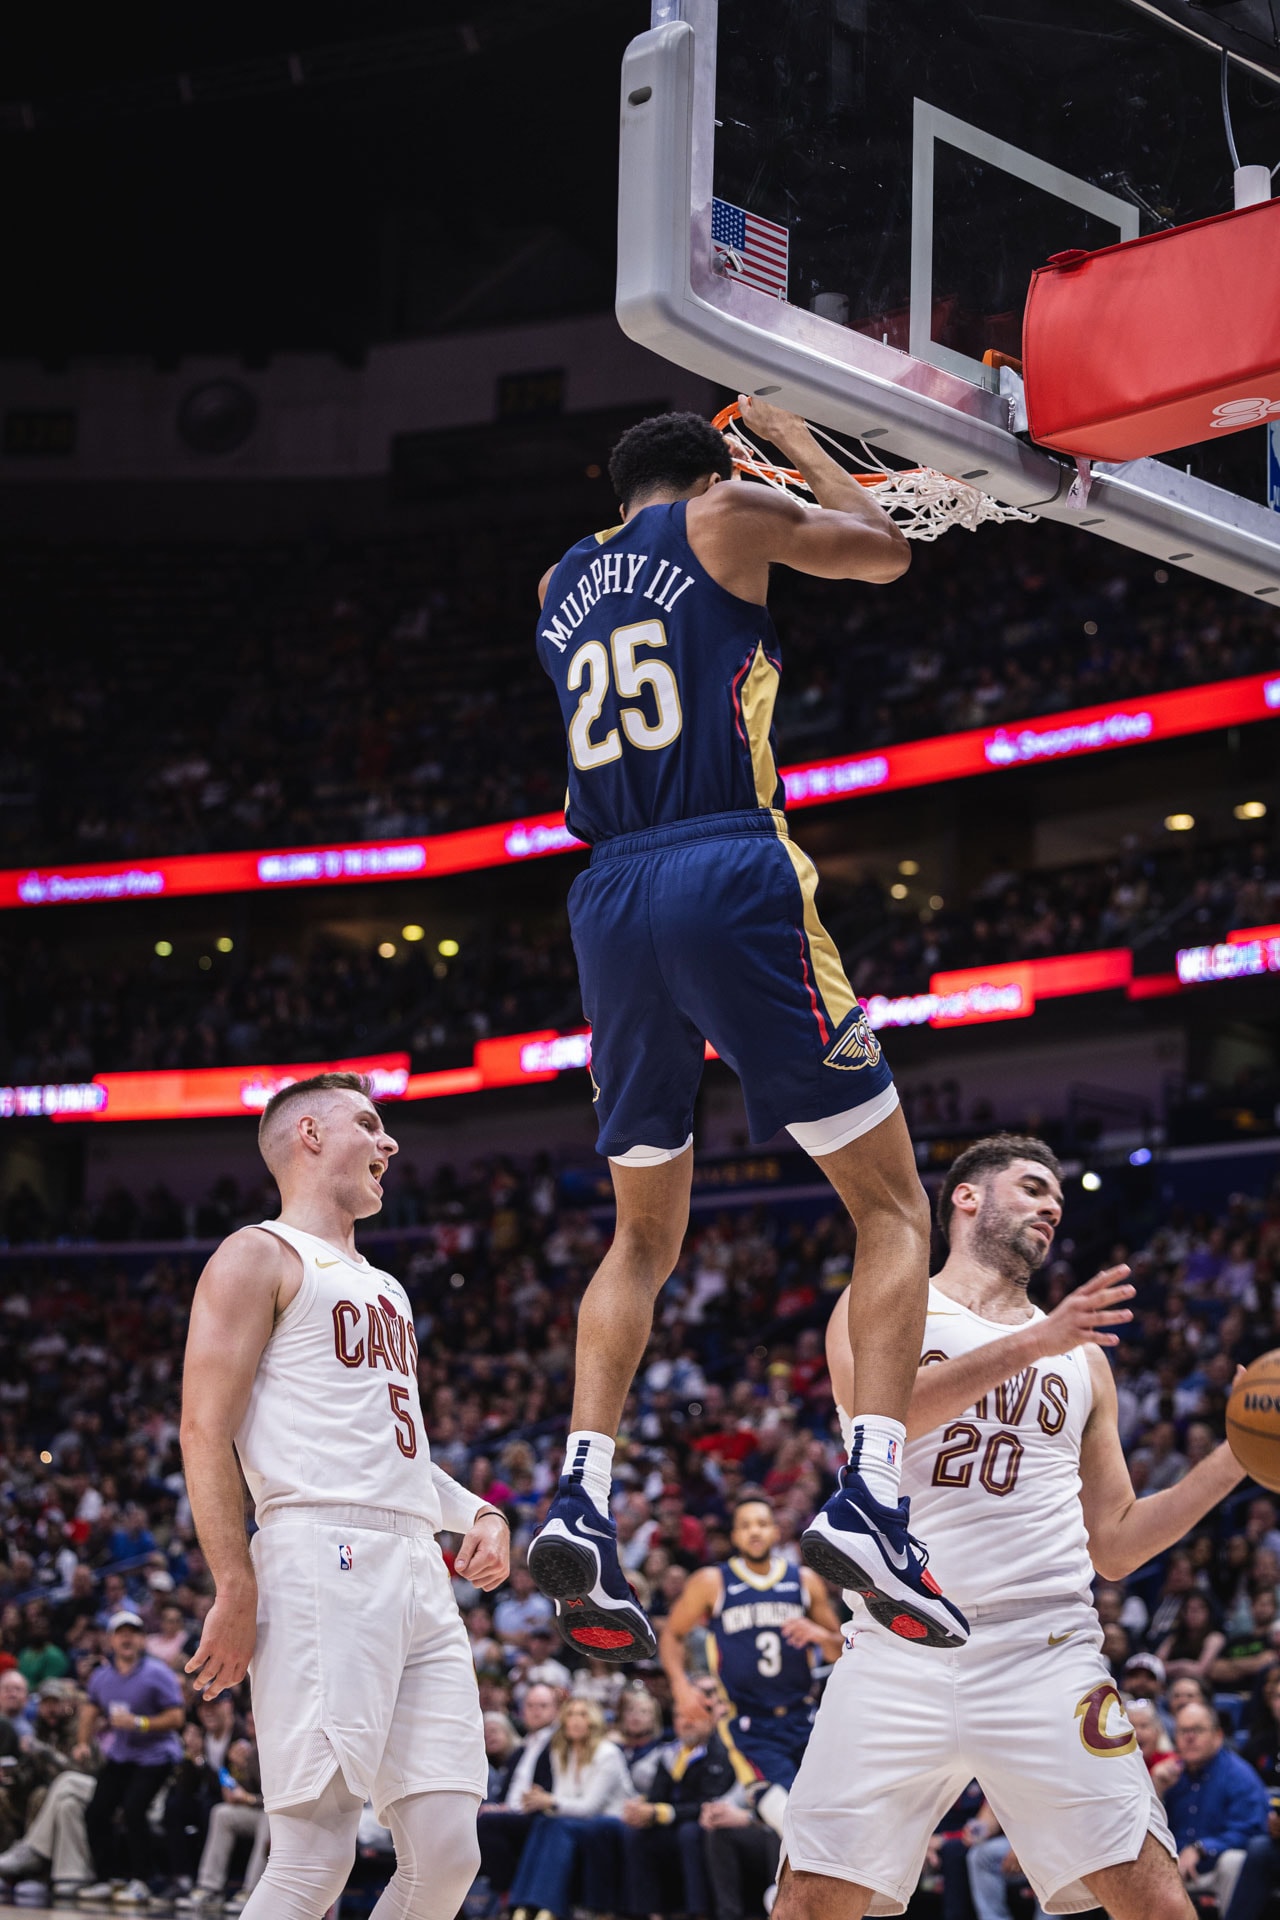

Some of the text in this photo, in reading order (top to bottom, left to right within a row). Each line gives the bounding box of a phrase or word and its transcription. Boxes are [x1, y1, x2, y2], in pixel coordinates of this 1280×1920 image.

[541, 553, 695, 653] MURPHY III
[567, 618, 682, 771] 25
[388, 1382, 418, 1459] 5
[931, 1422, 1024, 1497] 20
[755, 1631, 781, 1677] 3
